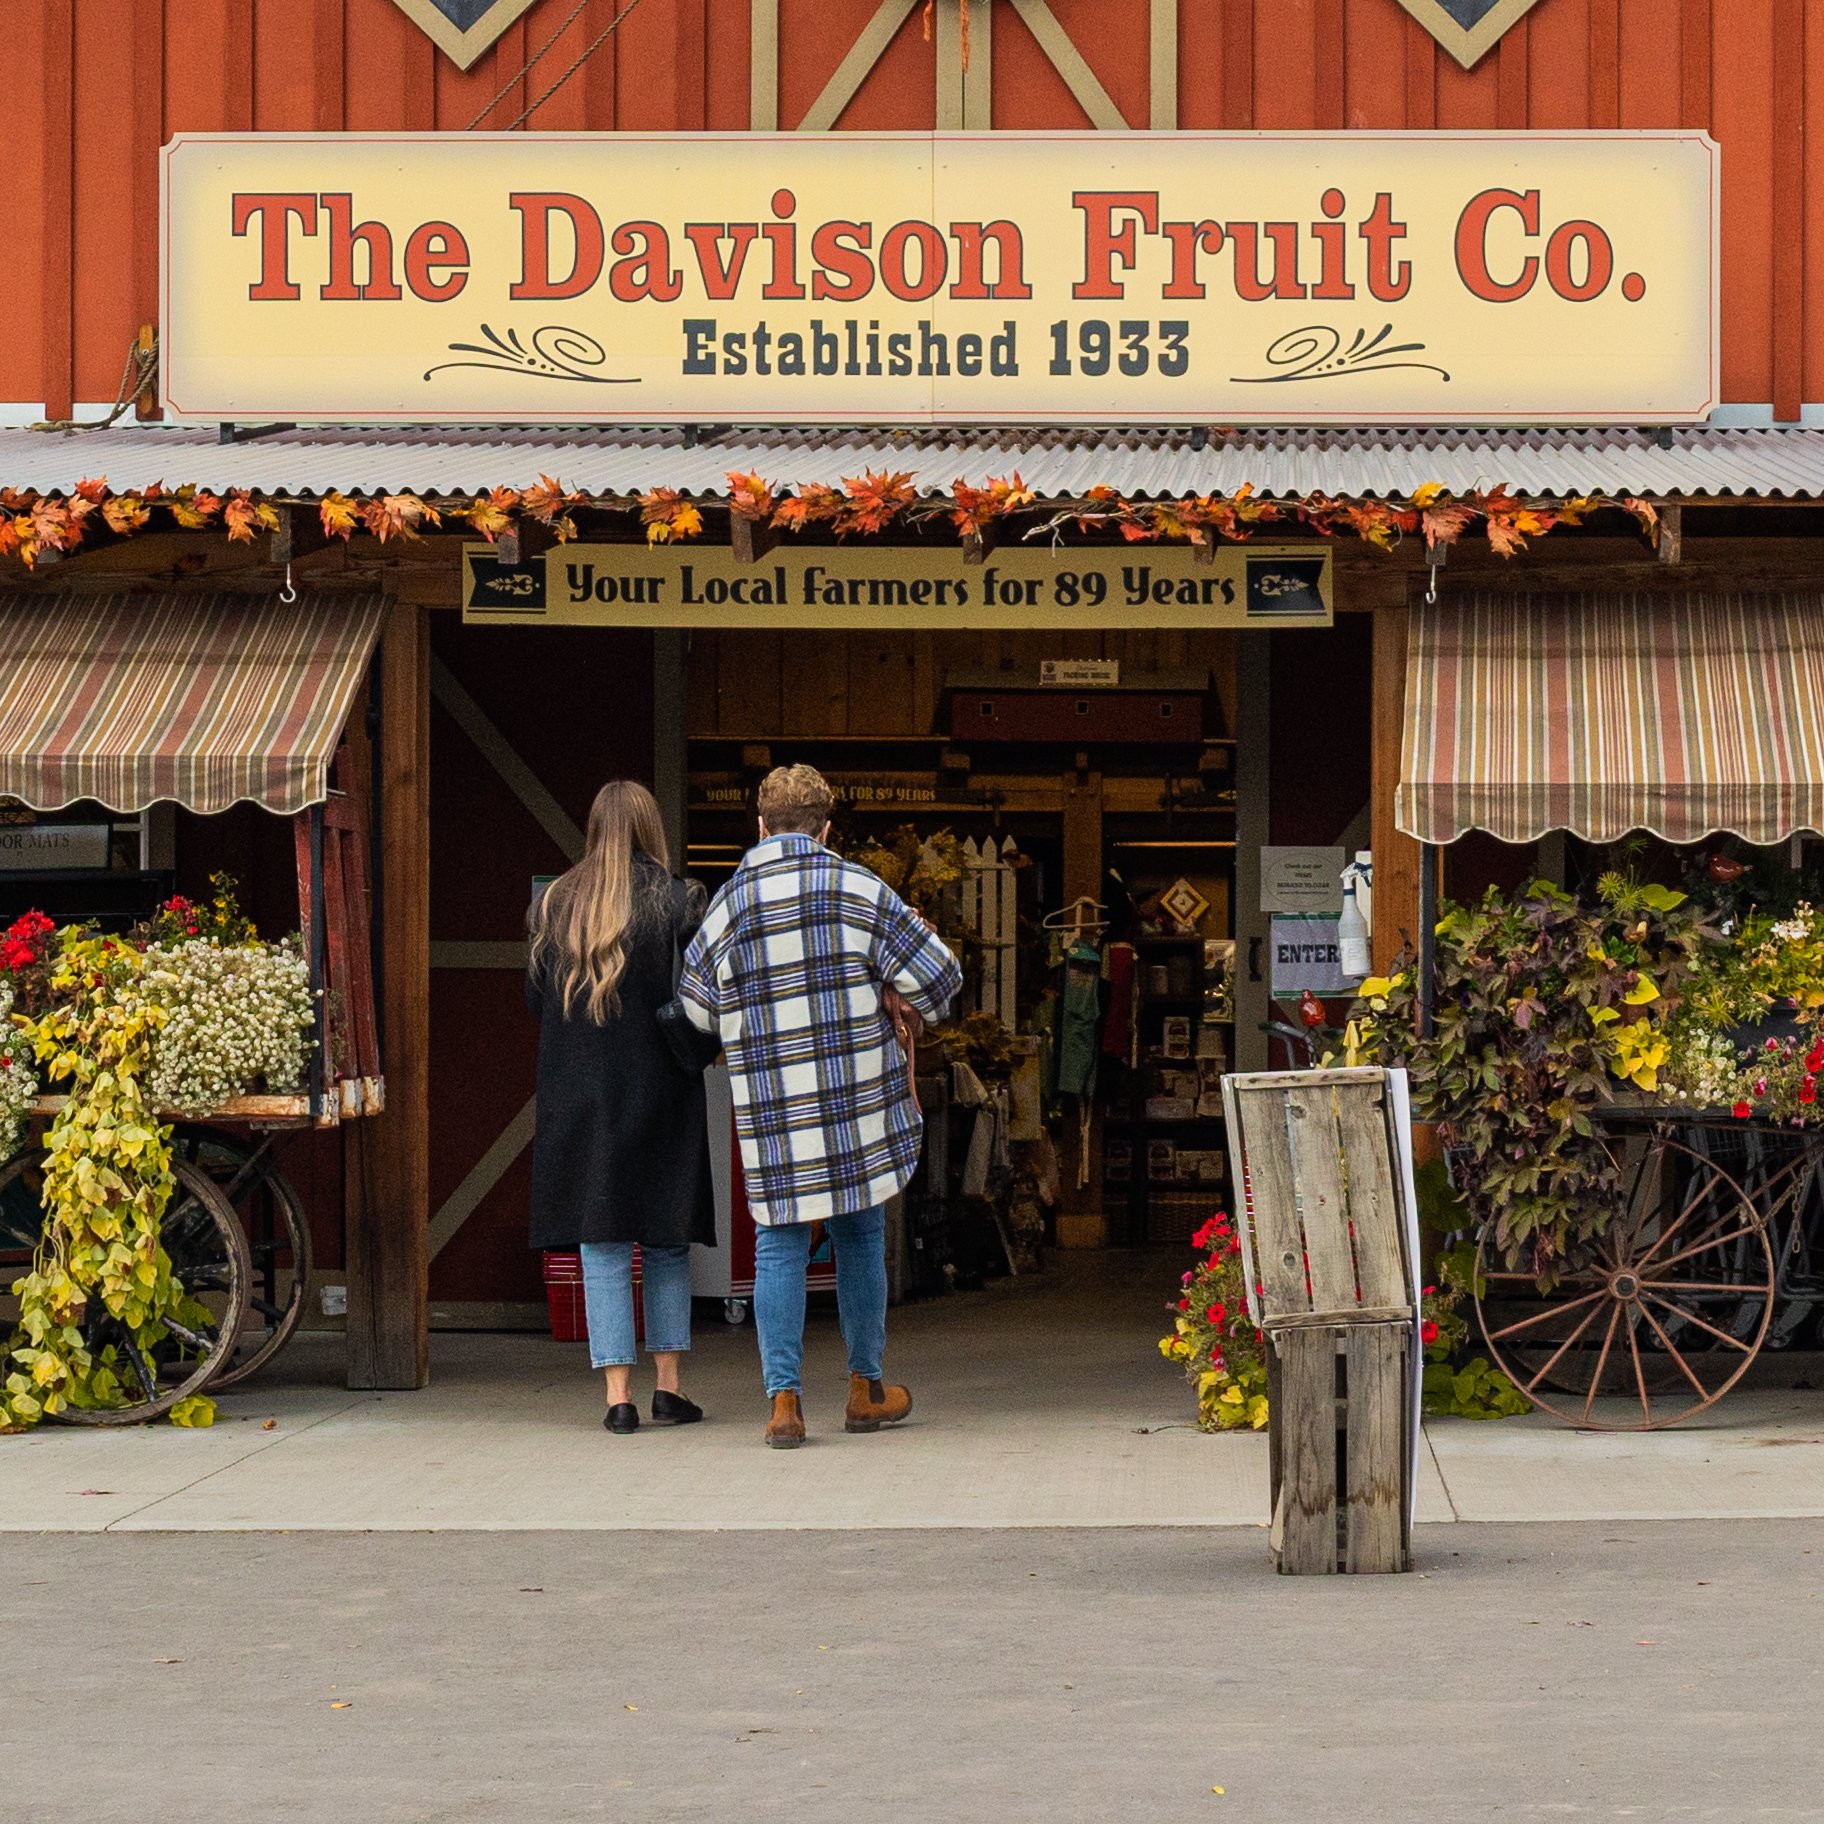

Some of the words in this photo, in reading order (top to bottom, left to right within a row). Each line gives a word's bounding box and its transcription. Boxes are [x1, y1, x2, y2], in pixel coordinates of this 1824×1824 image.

[231, 192, 471, 303] The
[509, 188, 1032, 303] Davison
[1071, 187, 1412, 303] Fruit
[1454, 188, 1647, 303] Co.
[682, 319, 1018, 377] Established
[1049, 319, 1191, 377] 1933
[565, 563, 665, 604] Your
[680, 565, 787, 606] Local
[803, 566, 969, 606] Farmers
[983, 567, 1044, 607] for
[1054, 571, 1107, 607] 89
[1121, 566, 1236, 606] Years
[28, 832, 69, 849] MATS
[1277, 943, 1340, 964] ENTER
